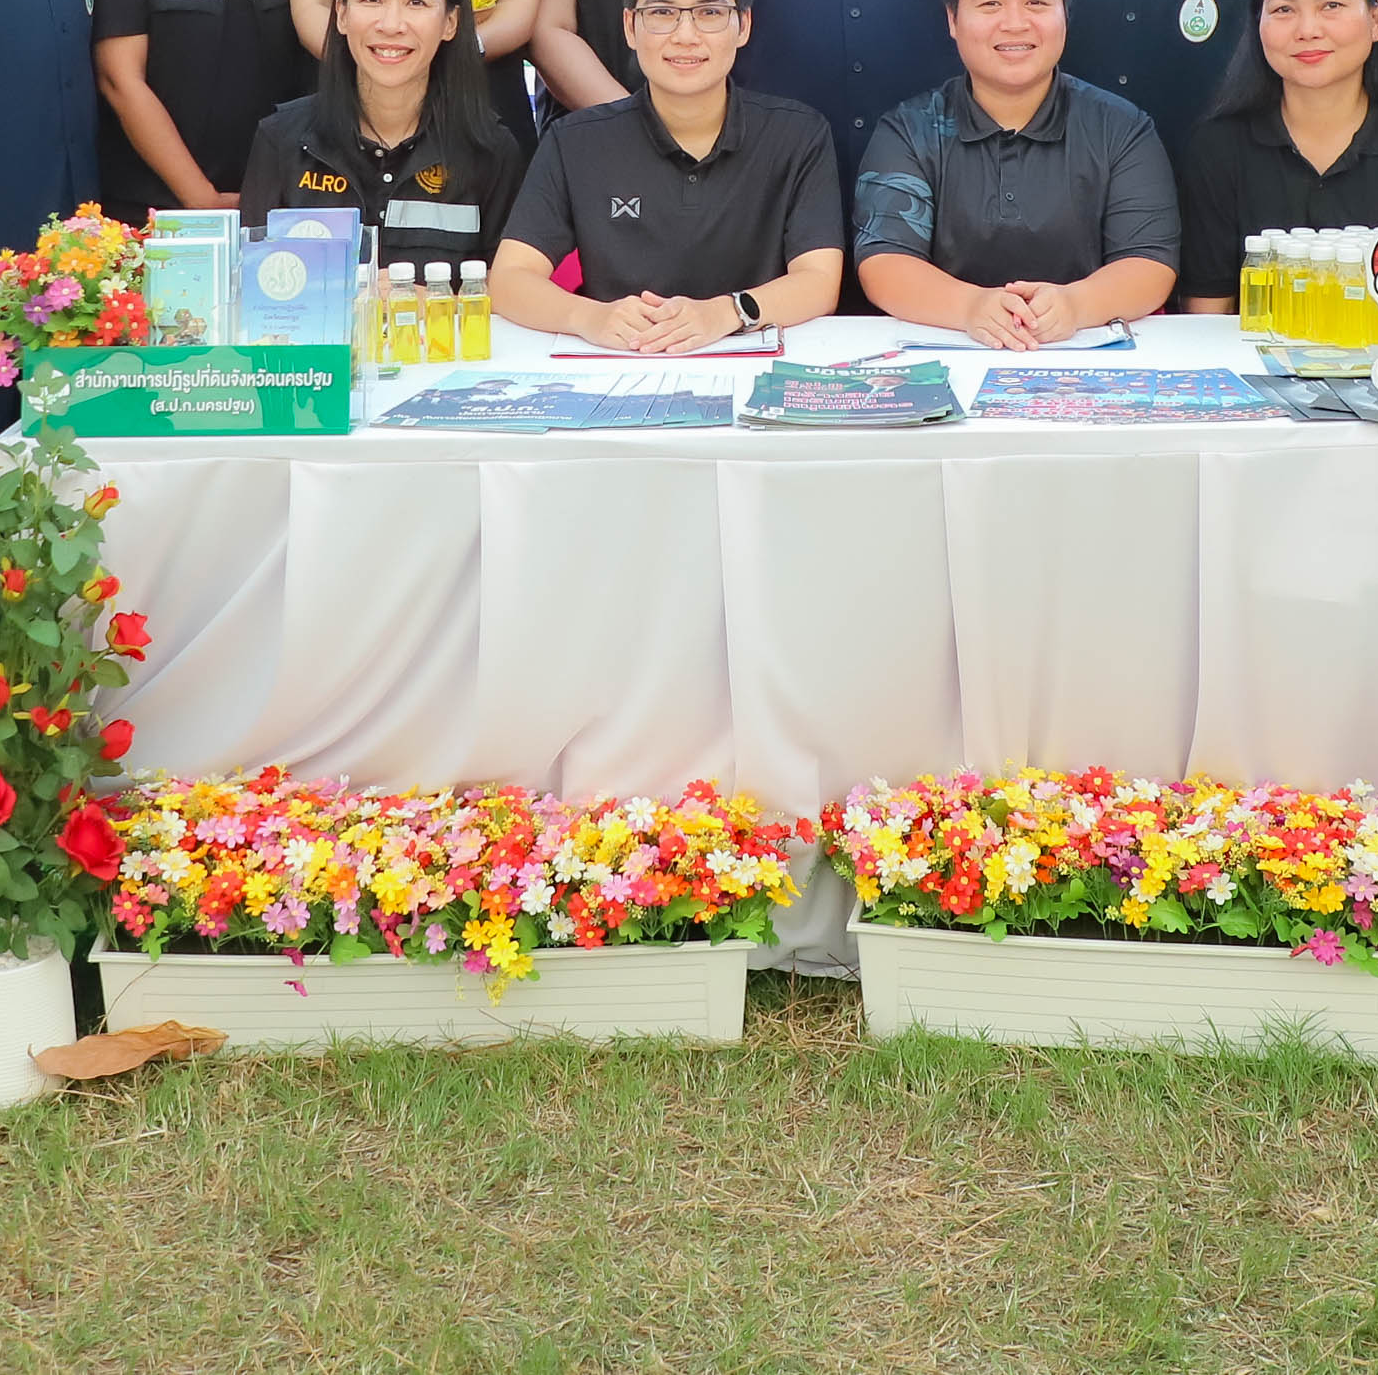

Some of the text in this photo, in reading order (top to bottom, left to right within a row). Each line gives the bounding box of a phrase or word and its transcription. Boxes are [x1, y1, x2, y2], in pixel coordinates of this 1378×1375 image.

[298, 170, 348, 193] ALRO
[75, 364, 333, 394] สำนักงานการปฏิรูปที่ดินจังหวัดนครปฐม
[150, 397, 256, 415] (ส.ป.ก.นครปฐม)
